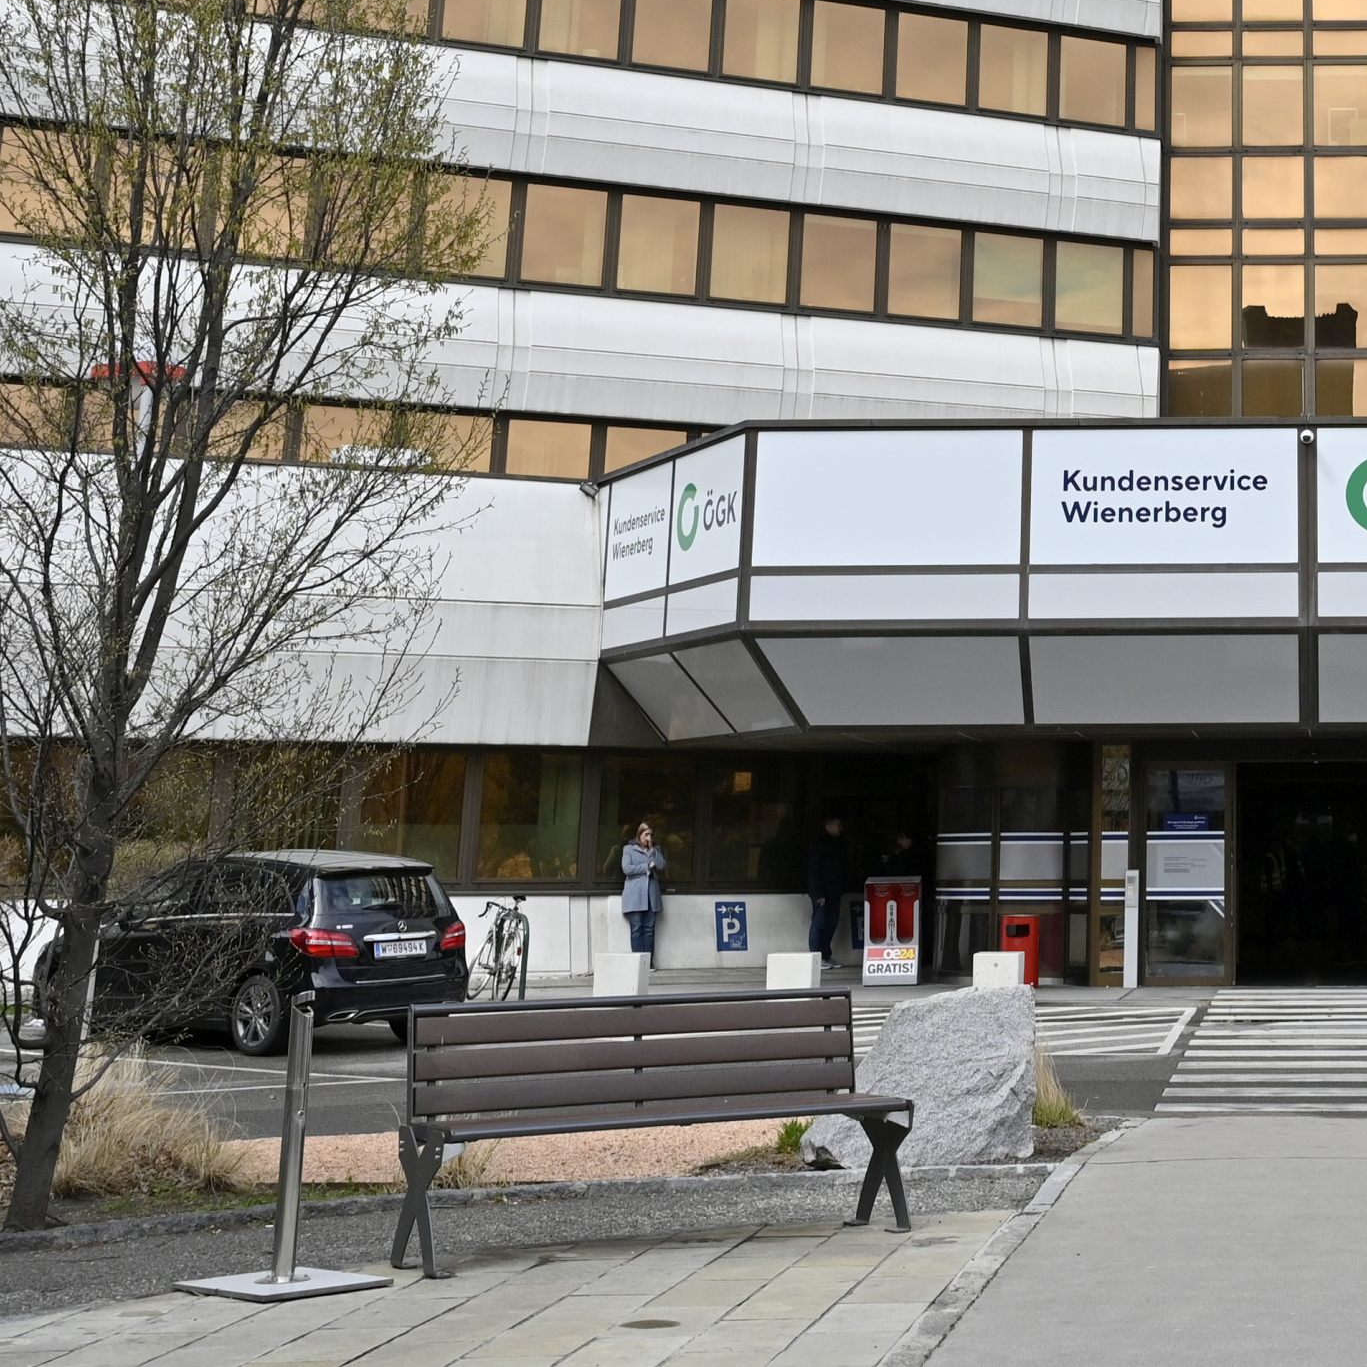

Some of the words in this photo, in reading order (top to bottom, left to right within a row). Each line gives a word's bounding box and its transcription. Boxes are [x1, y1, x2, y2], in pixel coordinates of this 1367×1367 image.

[1062, 469, 1269, 492] Kundenservice
[613, 506, 666, 536] Kundenservice
[703, 489, 738, 531] ÖGK
[1061, 500, 1227, 529] Wienerberg
[612, 536, 654, 561] Wienerberg
[883, 948, 915, 960] oe24
[867, 963, 914, 974] GRATIS!
